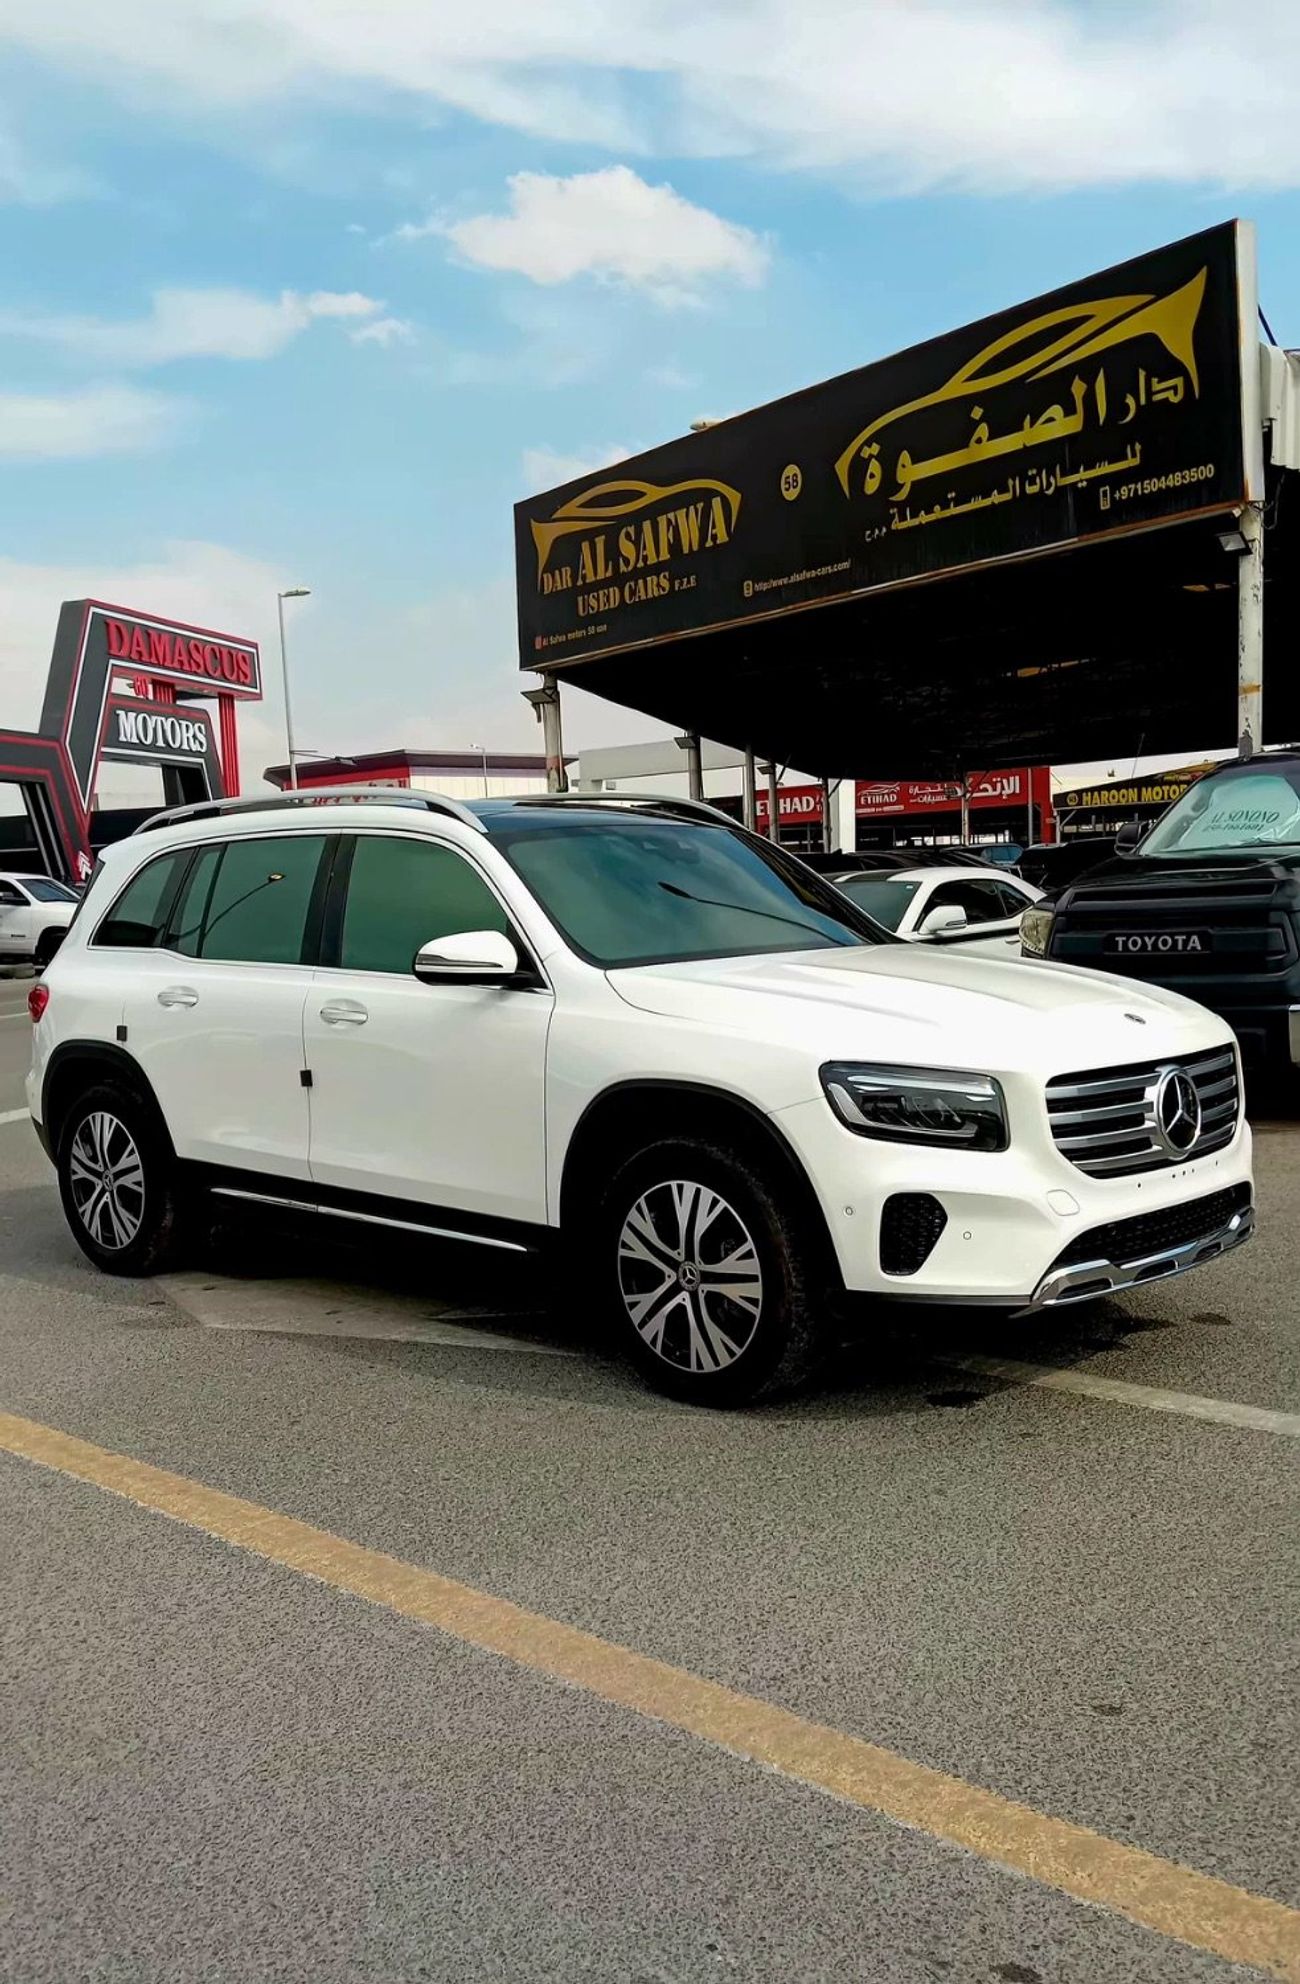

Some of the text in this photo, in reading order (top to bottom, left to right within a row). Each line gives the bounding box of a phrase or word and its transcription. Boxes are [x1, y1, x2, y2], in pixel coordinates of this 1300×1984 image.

[862, 367, 1185, 501] دار الصفوة
[784, 473, 799, 492] 58
[1025, 442, 1142, 497] للسيارات
[1114, 463, 1215, 500] +971504483500
[890, 475, 1020, 531] المستعملة
[543, 496, 729, 595] DAR AL SAFWA
[577, 586, 620, 617] USED
[624, 571, 671, 604] CARS
[105, 618, 252, 684] DAMASCUS
[116, 710, 208, 753] MOTORS
[1082, 788, 1138, 806] HAROON
[1115, 935, 1201, 952] TOYOTA
